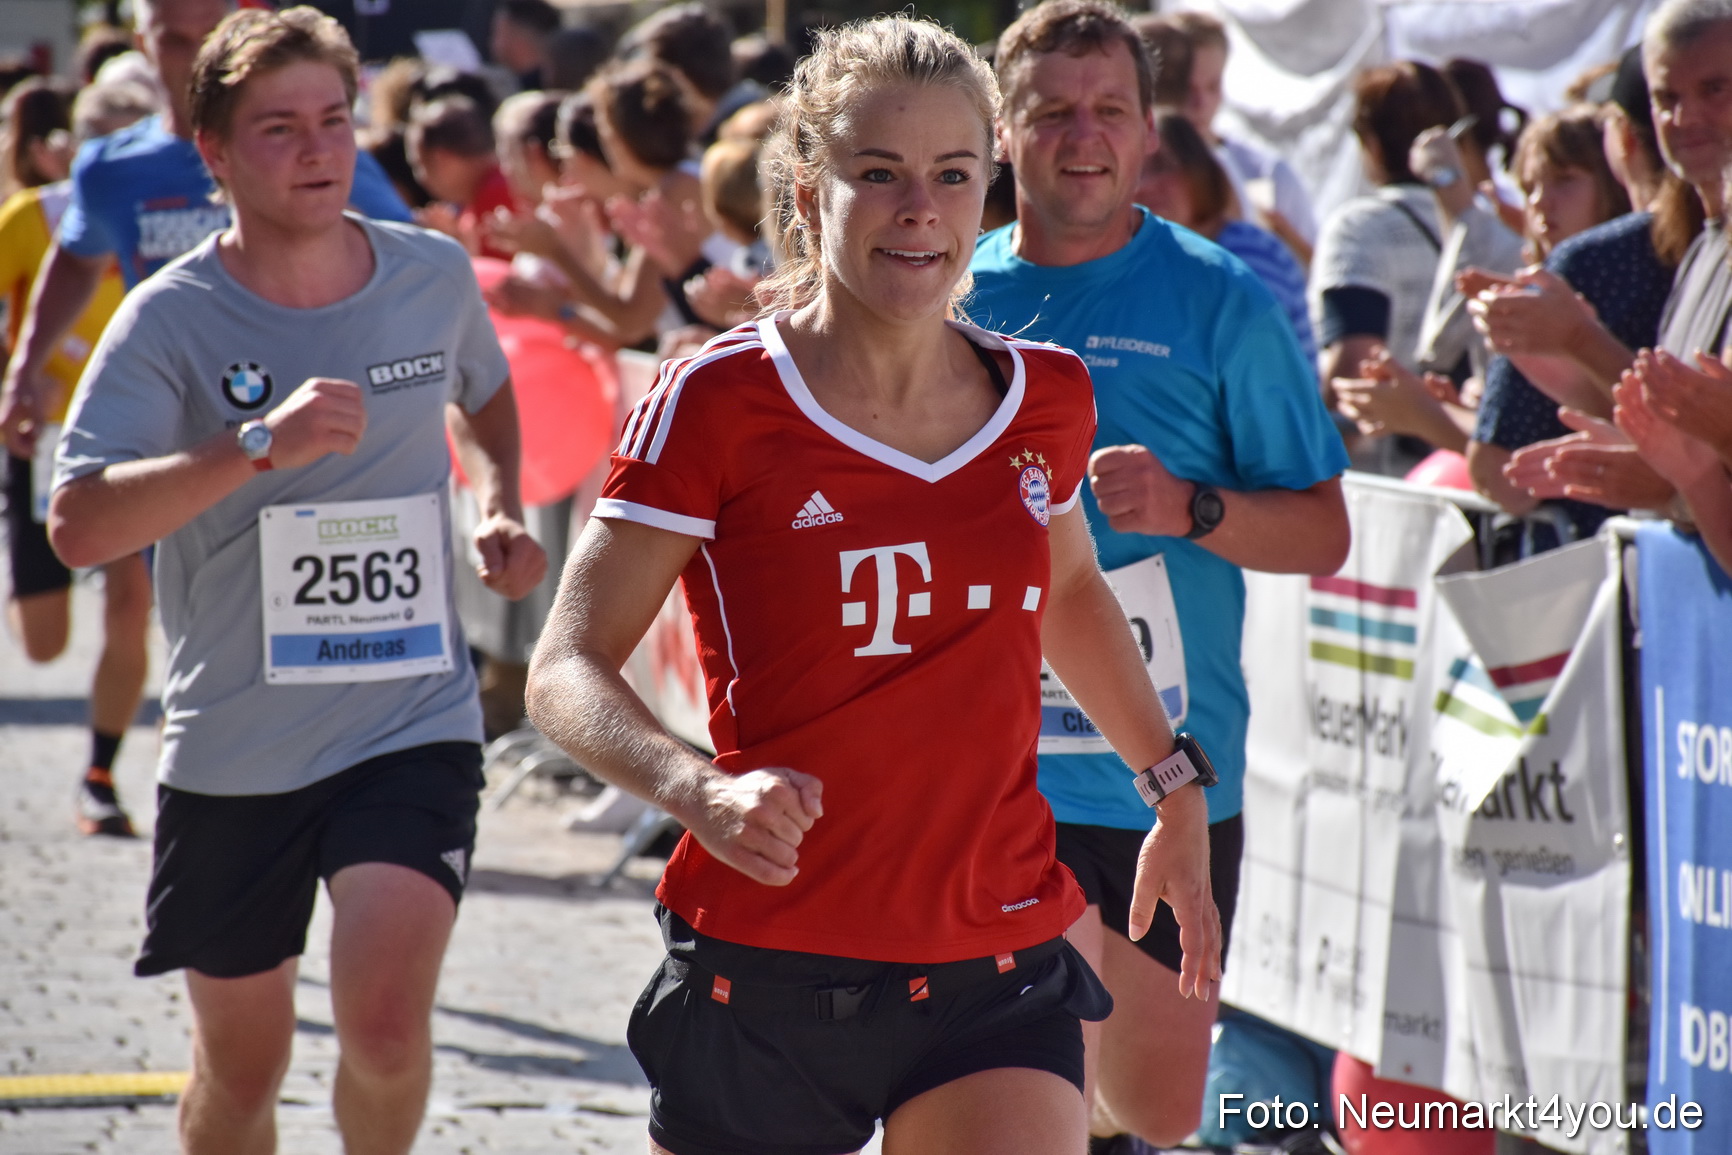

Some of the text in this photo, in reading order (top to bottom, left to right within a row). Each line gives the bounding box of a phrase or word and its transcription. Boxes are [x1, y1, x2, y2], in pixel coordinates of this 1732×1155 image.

[367, 351, 445, 388] BOCK
[317, 514, 399, 539] BOCK
[791, 512, 844, 530] adidas
[292, 547, 422, 606] 2563
[839, 542, 932, 657] T
[306, 610, 400, 626] PARTL Neumarkt
[316, 637, 406, 662] Andreas
[1041, 690, 1071, 700] ARTL
[1062, 711, 1097, 733] Cla
[1472, 755, 1575, 824] arkt
[1679, 860, 1732, 931] ONLI
